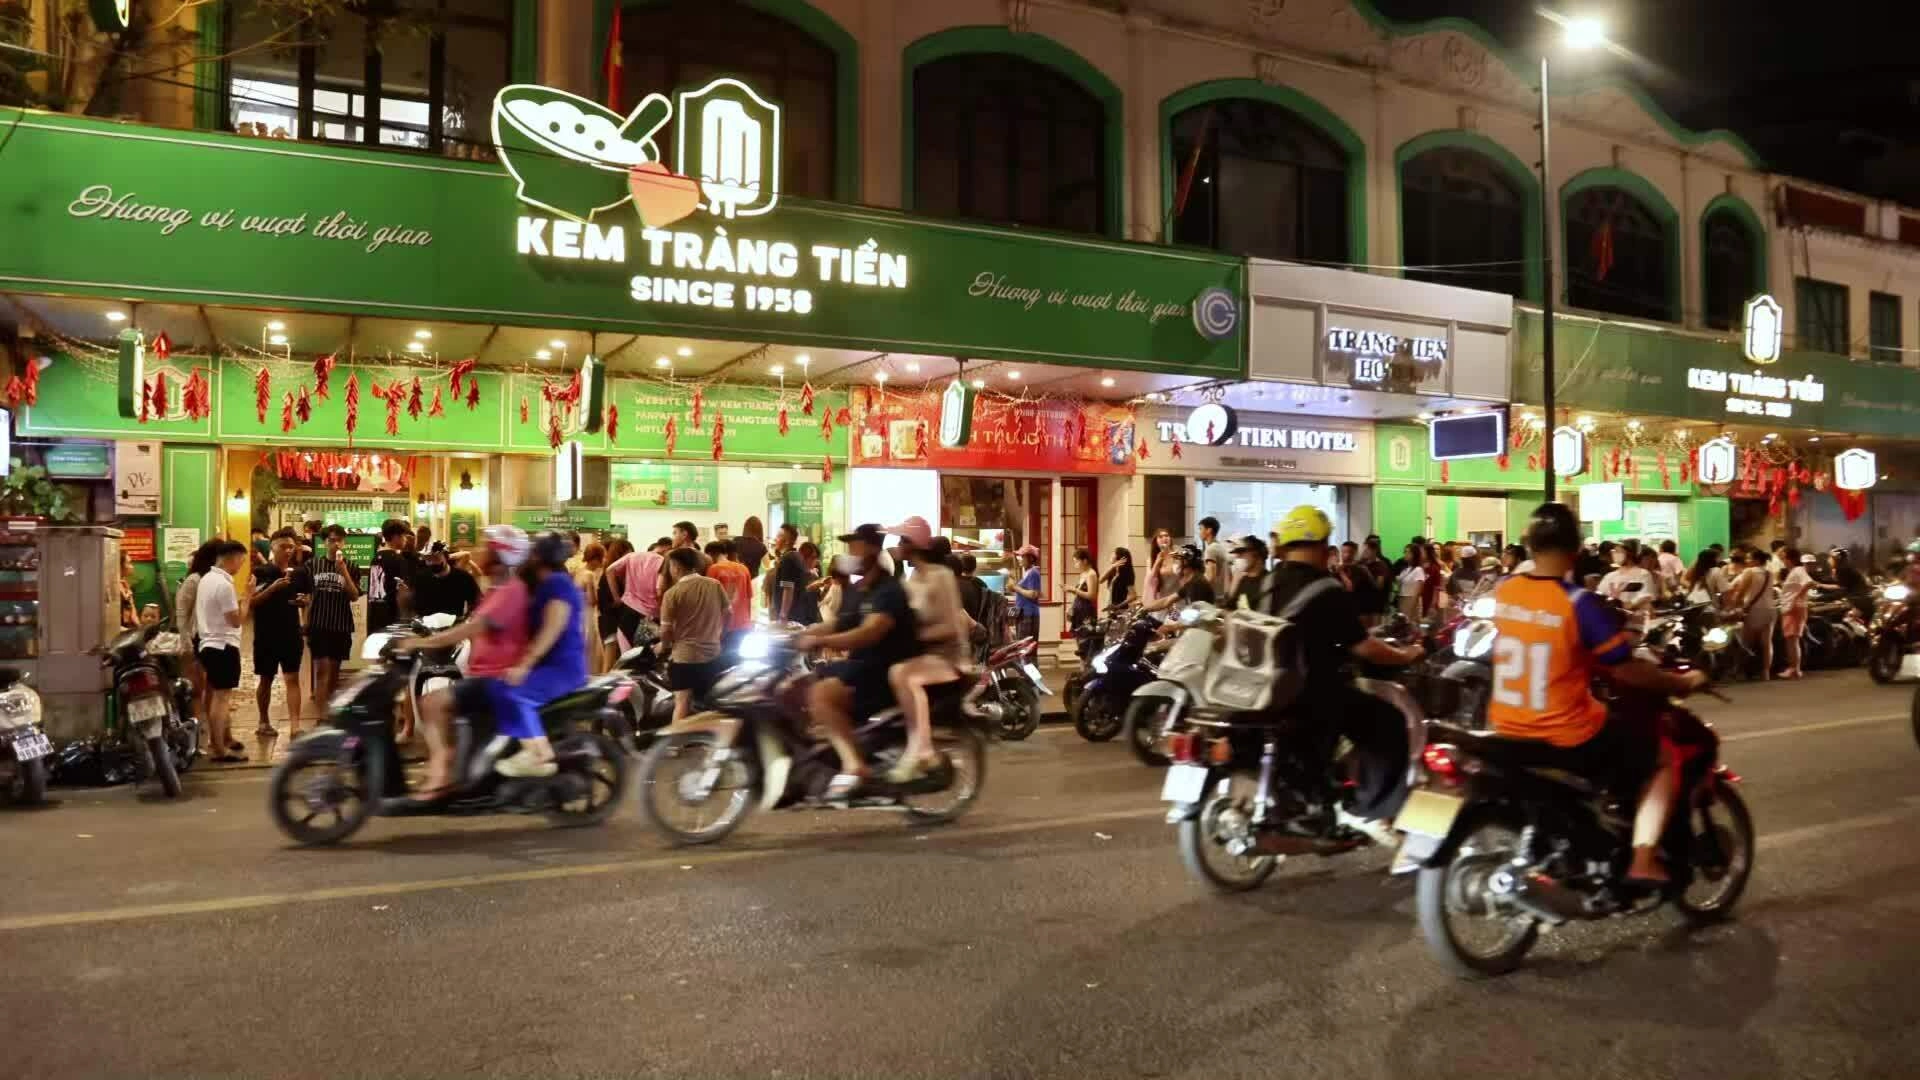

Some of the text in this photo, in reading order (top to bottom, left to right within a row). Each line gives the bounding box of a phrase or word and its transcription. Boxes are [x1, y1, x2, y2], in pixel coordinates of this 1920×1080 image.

[366, 224, 433, 253] gian
[516, 217, 908, 288] KEM TRÀNG TIỀN
[630, 276, 813, 314] SINCE 1958
[1329, 327, 1398, 355] TRANG
[1238, 427, 1286, 449] TIEN
[1290, 429, 1358, 452] HOTEL
[1494, 636, 1553, 712] 21
